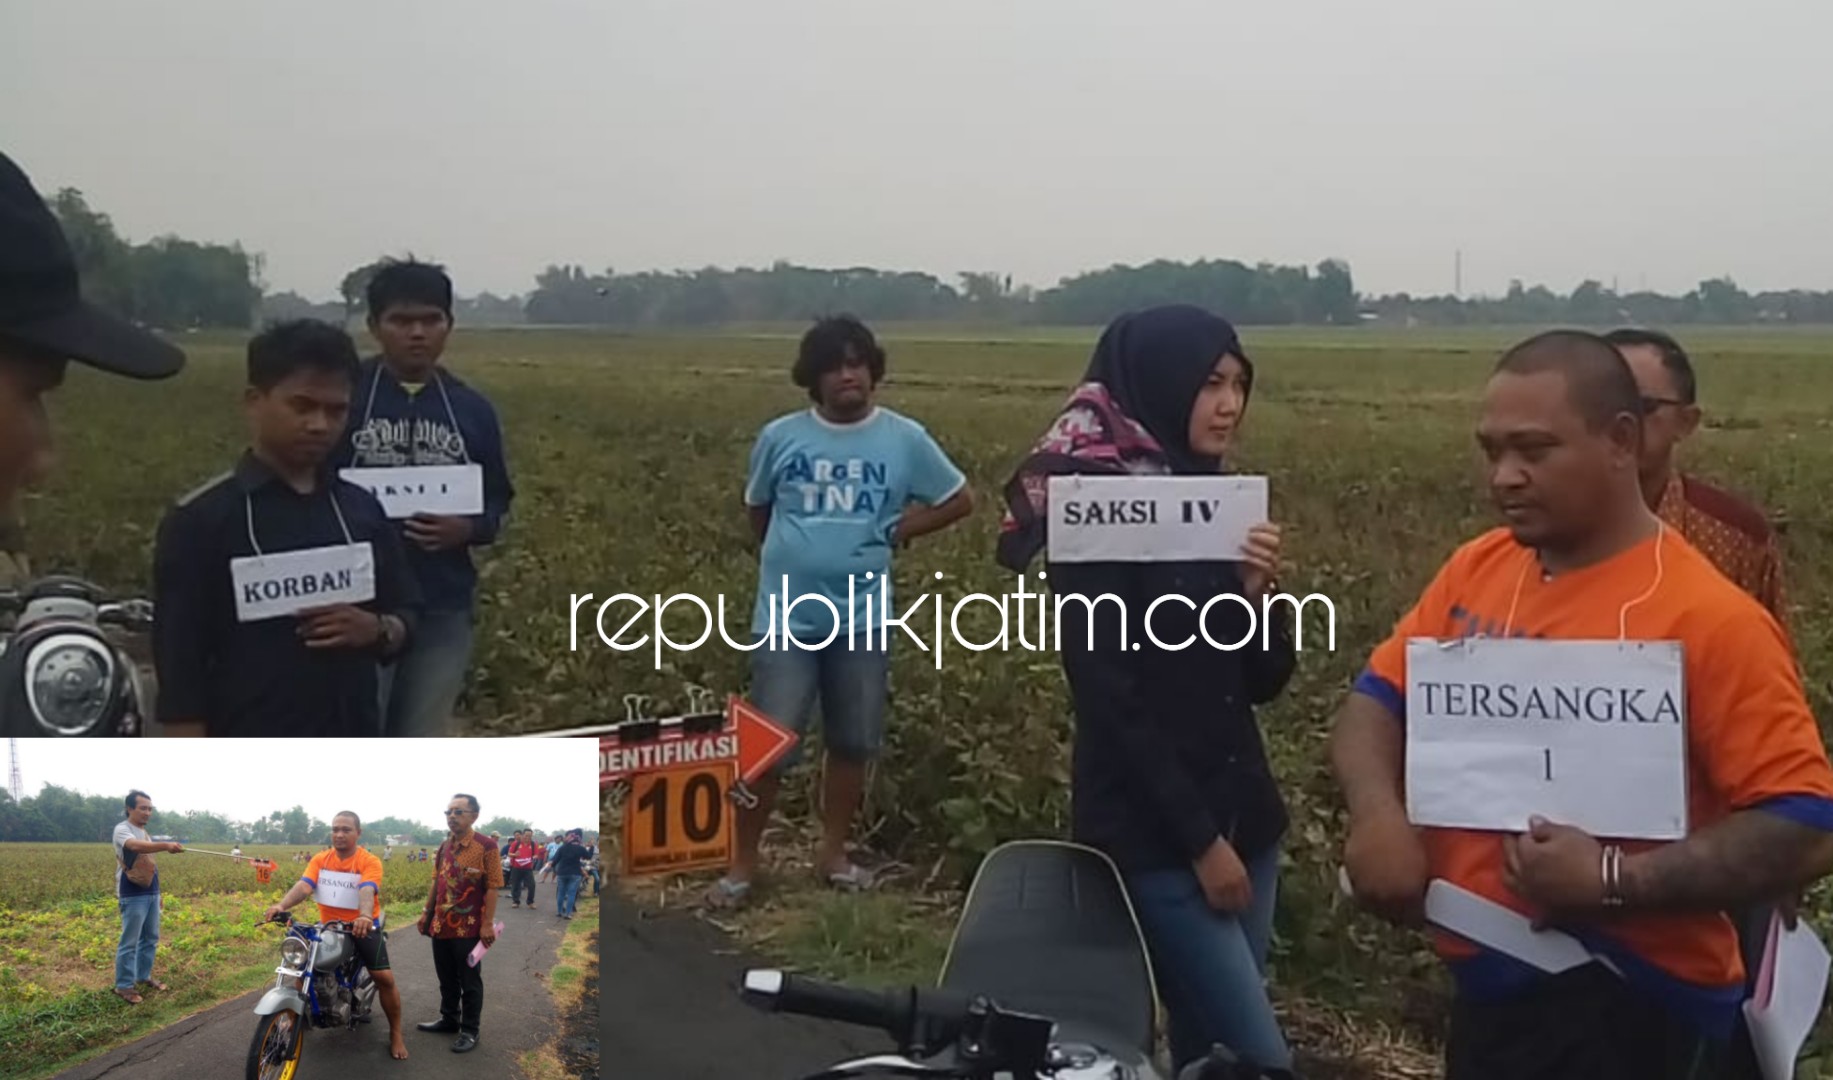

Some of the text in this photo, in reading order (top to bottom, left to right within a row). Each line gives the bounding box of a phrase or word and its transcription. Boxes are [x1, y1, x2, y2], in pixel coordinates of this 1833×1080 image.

[1063, 500, 1221, 525] SAKSI IV
[243, 569, 351, 604] KORBAN
[1418, 682, 1681, 724] TERSANGKA
[599, 736, 738, 773] DENTIFIKASI
[638, 772, 722, 848] 10
